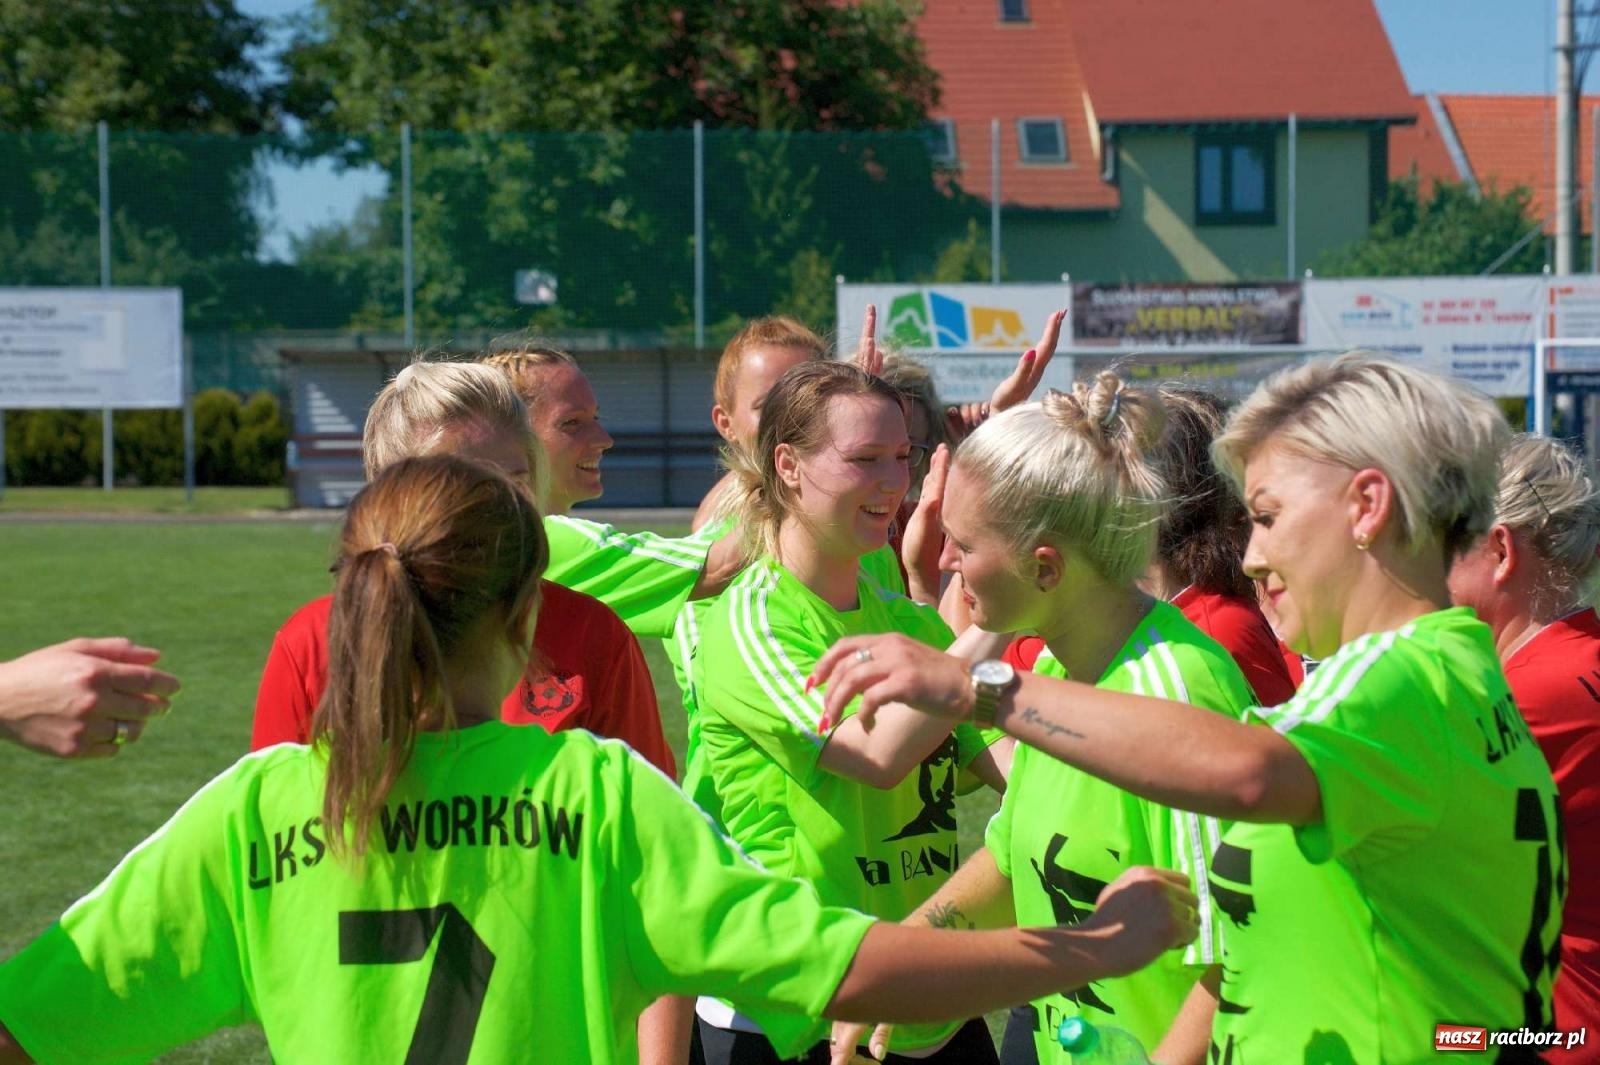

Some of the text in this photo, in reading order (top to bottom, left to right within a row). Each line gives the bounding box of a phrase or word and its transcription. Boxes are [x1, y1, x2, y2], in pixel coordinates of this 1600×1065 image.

[248, 817, 326, 890] LKS
[379, 788, 584, 861] WORKÓW
[901, 843, 959, 881] BAN
[338, 901, 497, 1065] 7
